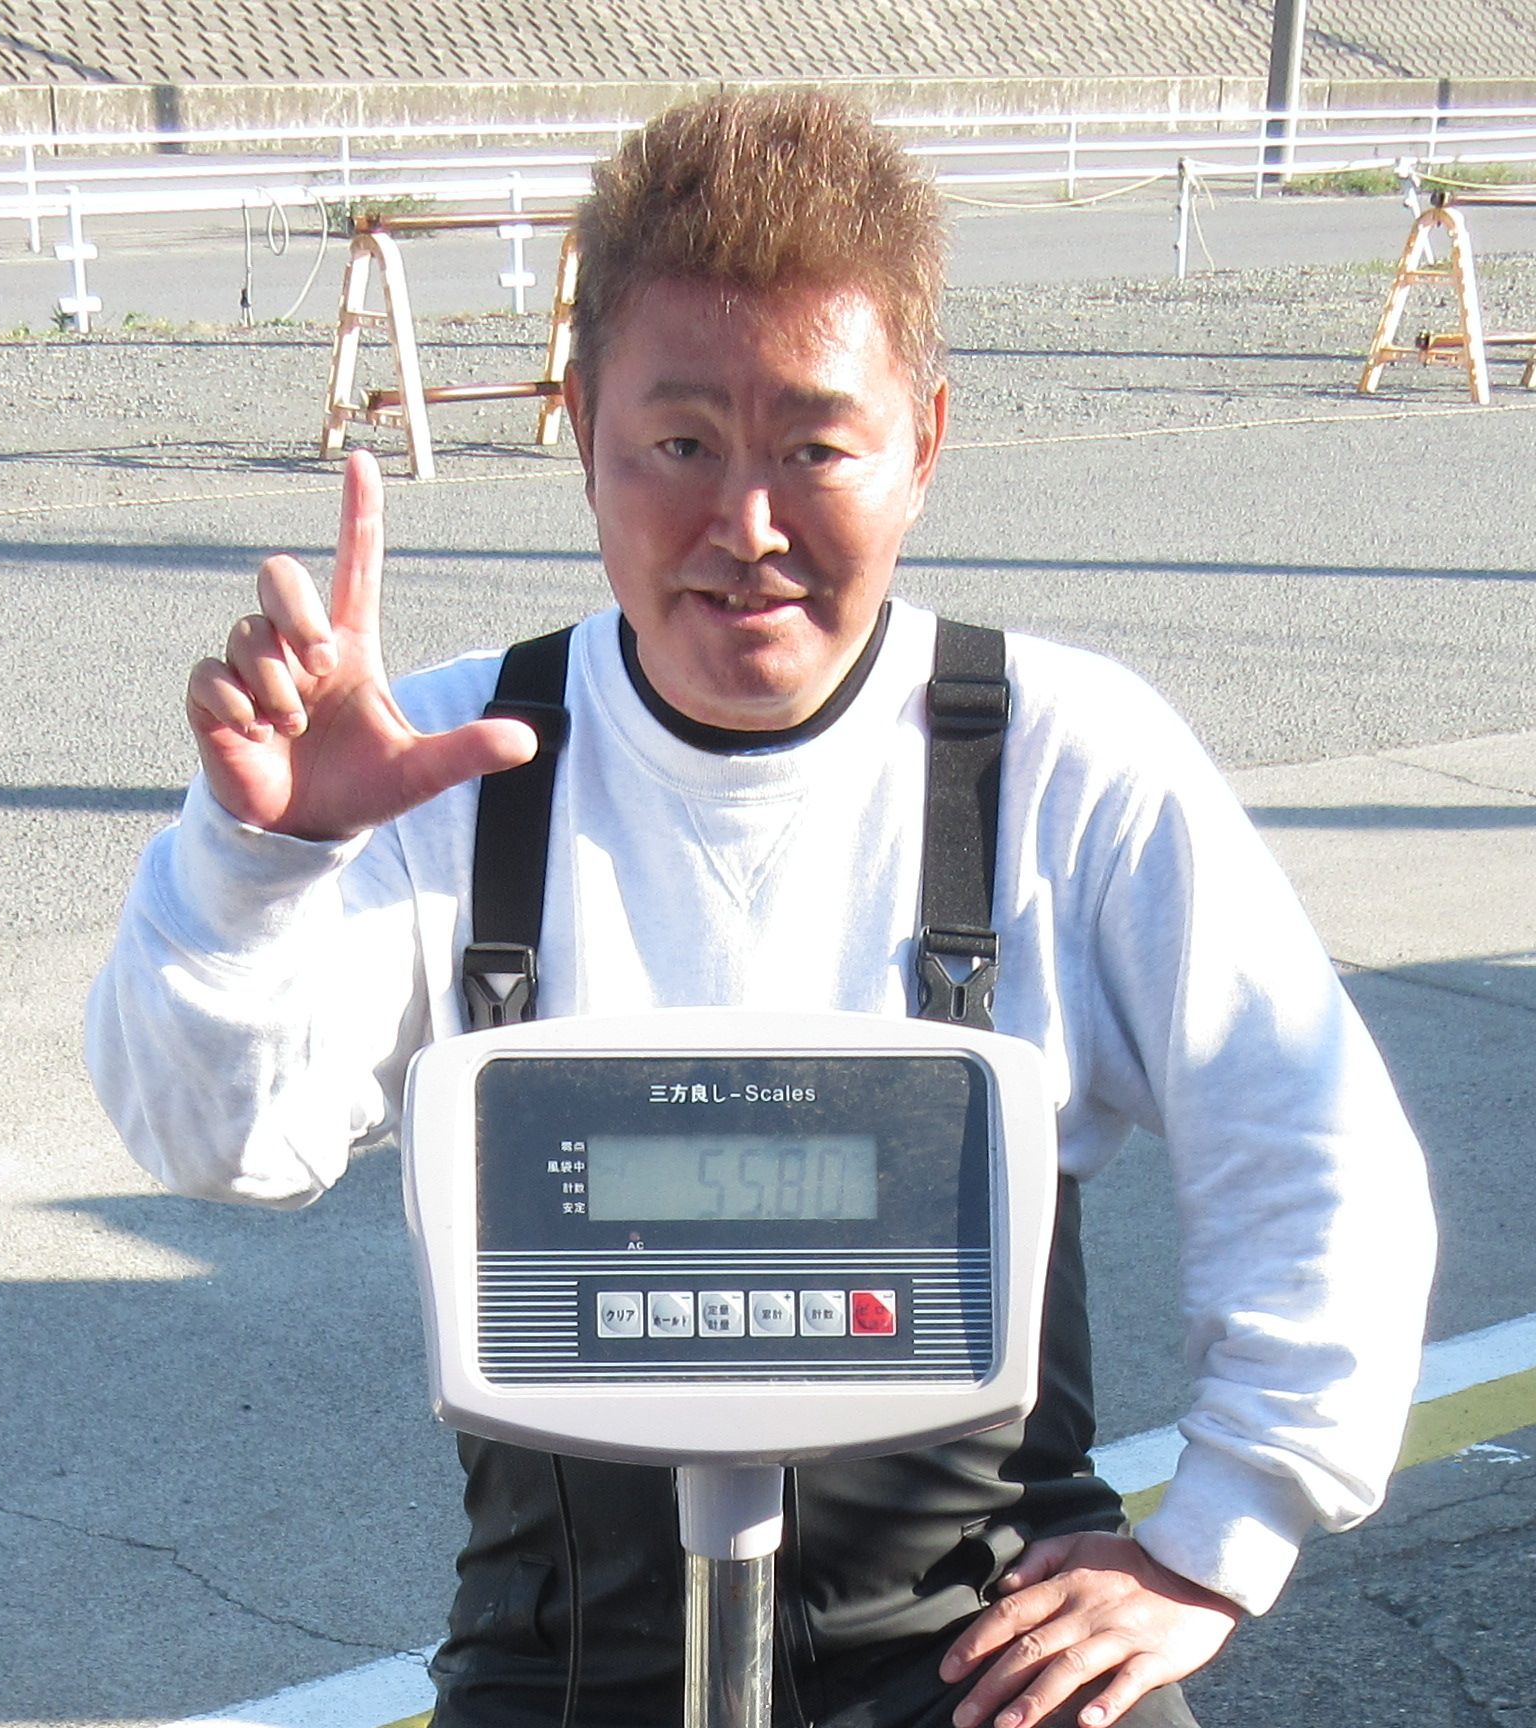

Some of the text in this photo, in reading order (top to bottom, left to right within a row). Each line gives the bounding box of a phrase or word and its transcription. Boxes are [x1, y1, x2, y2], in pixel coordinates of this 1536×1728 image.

[547, 1160, 586, 1173] 風袋中
[562, 1202, 586, 1214] 安定
[627, 1241, 645, 1251] AC
[606, 1309, 635, 1322] クリア
